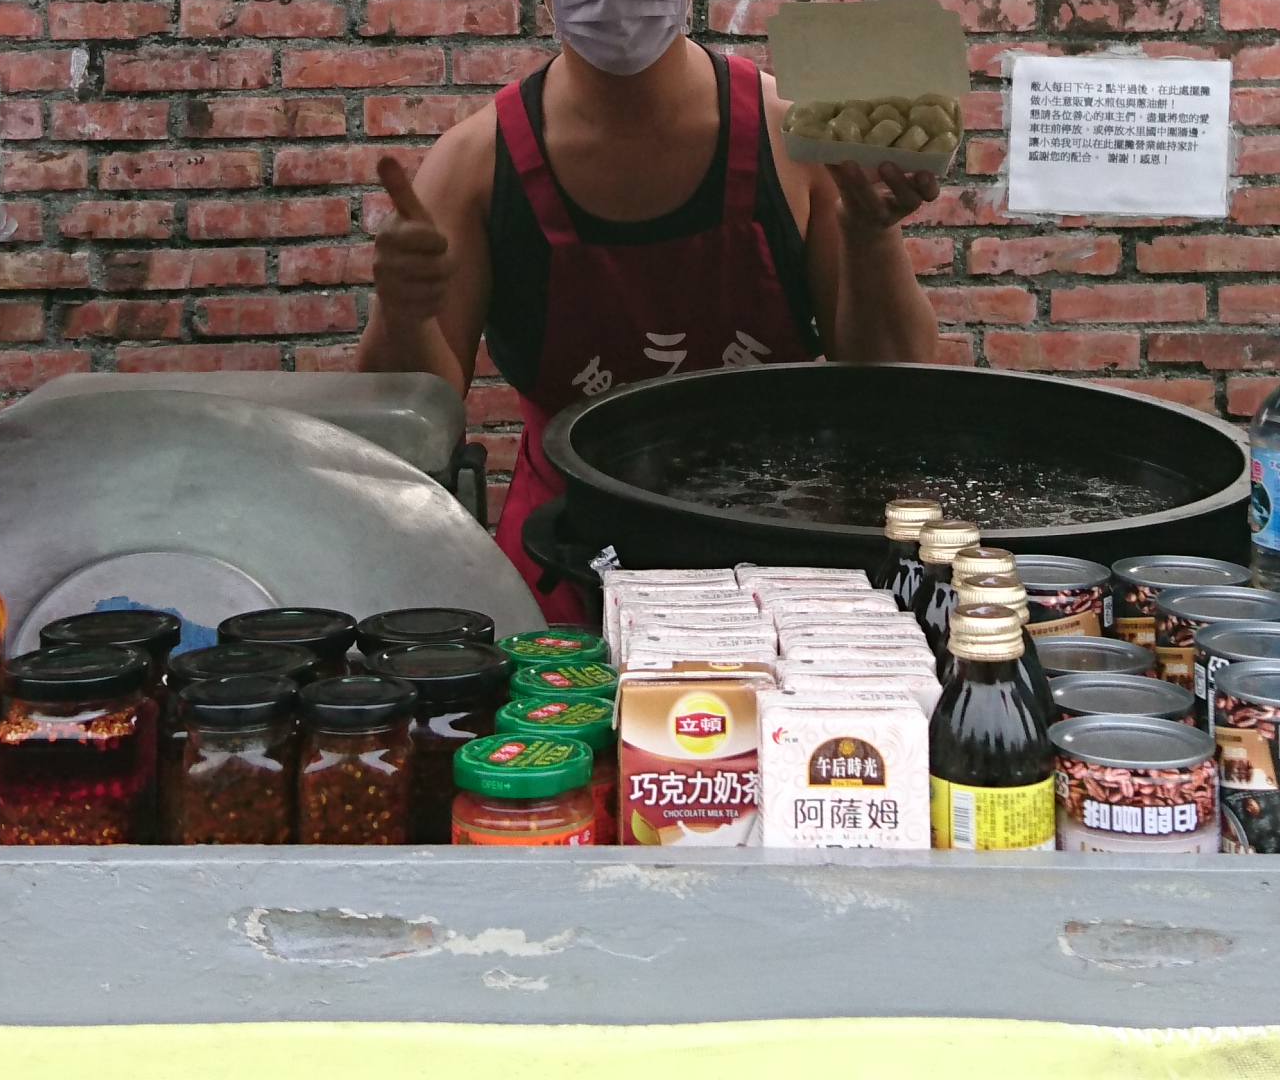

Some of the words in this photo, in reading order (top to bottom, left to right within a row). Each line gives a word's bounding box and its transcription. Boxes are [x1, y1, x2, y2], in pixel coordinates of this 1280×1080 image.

[678, 717, 722, 732] 立頓
[816, 757, 878, 778] 午后時光
[482, 780, 503, 790] OPEN
[629, 771, 762, 806] 巧克力奶茶
[663, 809, 705, 818] CHOCOLATE
[707, 809, 724, 817] MILK
[725, 809, 739, 817] TEA
[794, 798, 900, 830] 阿薩姆
[1083, 799, 1198, 835] 伯朗咖啡
